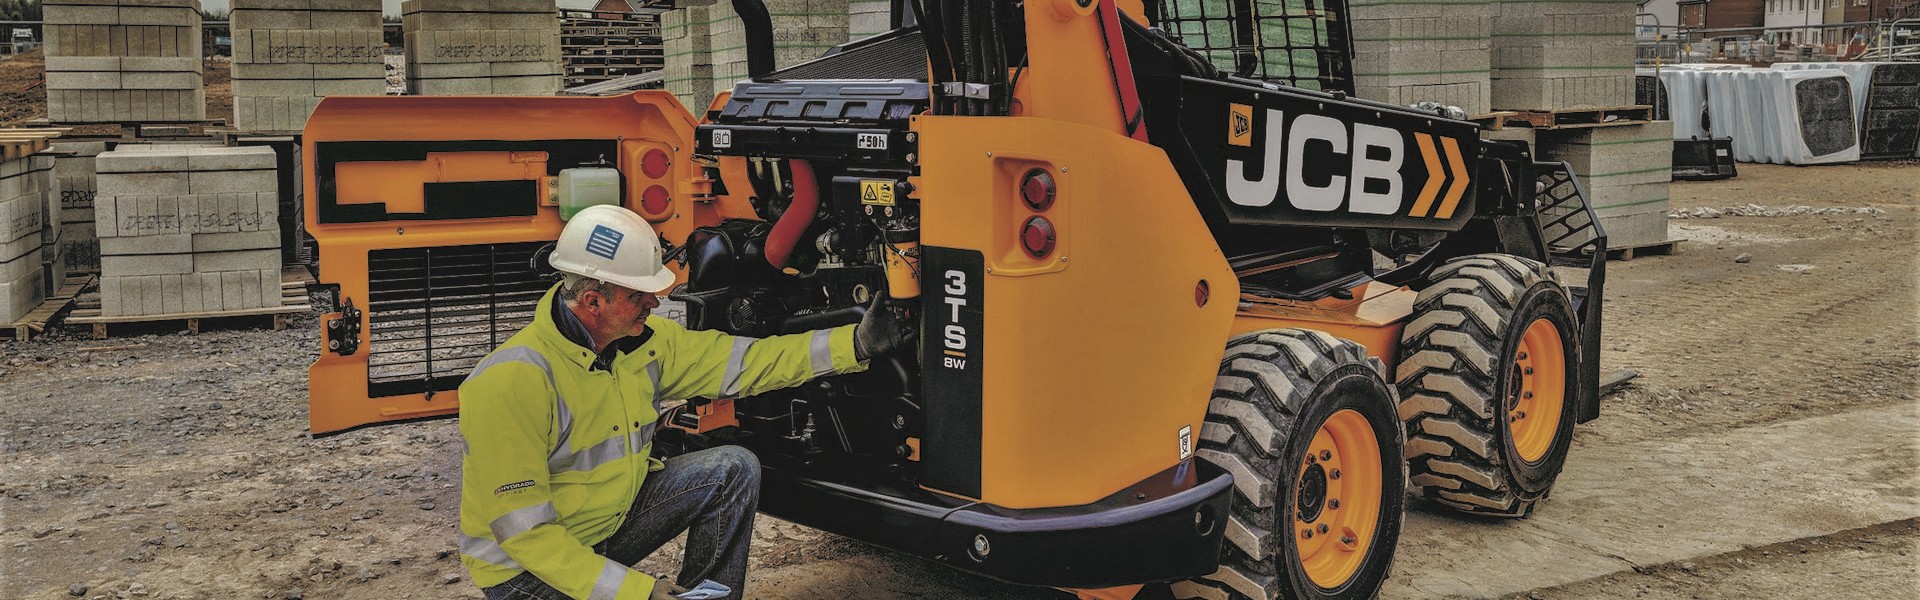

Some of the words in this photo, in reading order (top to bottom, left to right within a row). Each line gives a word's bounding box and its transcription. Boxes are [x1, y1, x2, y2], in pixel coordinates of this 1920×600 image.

[1234, 113, 1250, 136] JCB
[866, 135, 885, 148] 50h
[1226, 108, 1404, 215] JCB
[944, 269, 967, 350] 3TS
[943, 357, 966, 370] 8W
